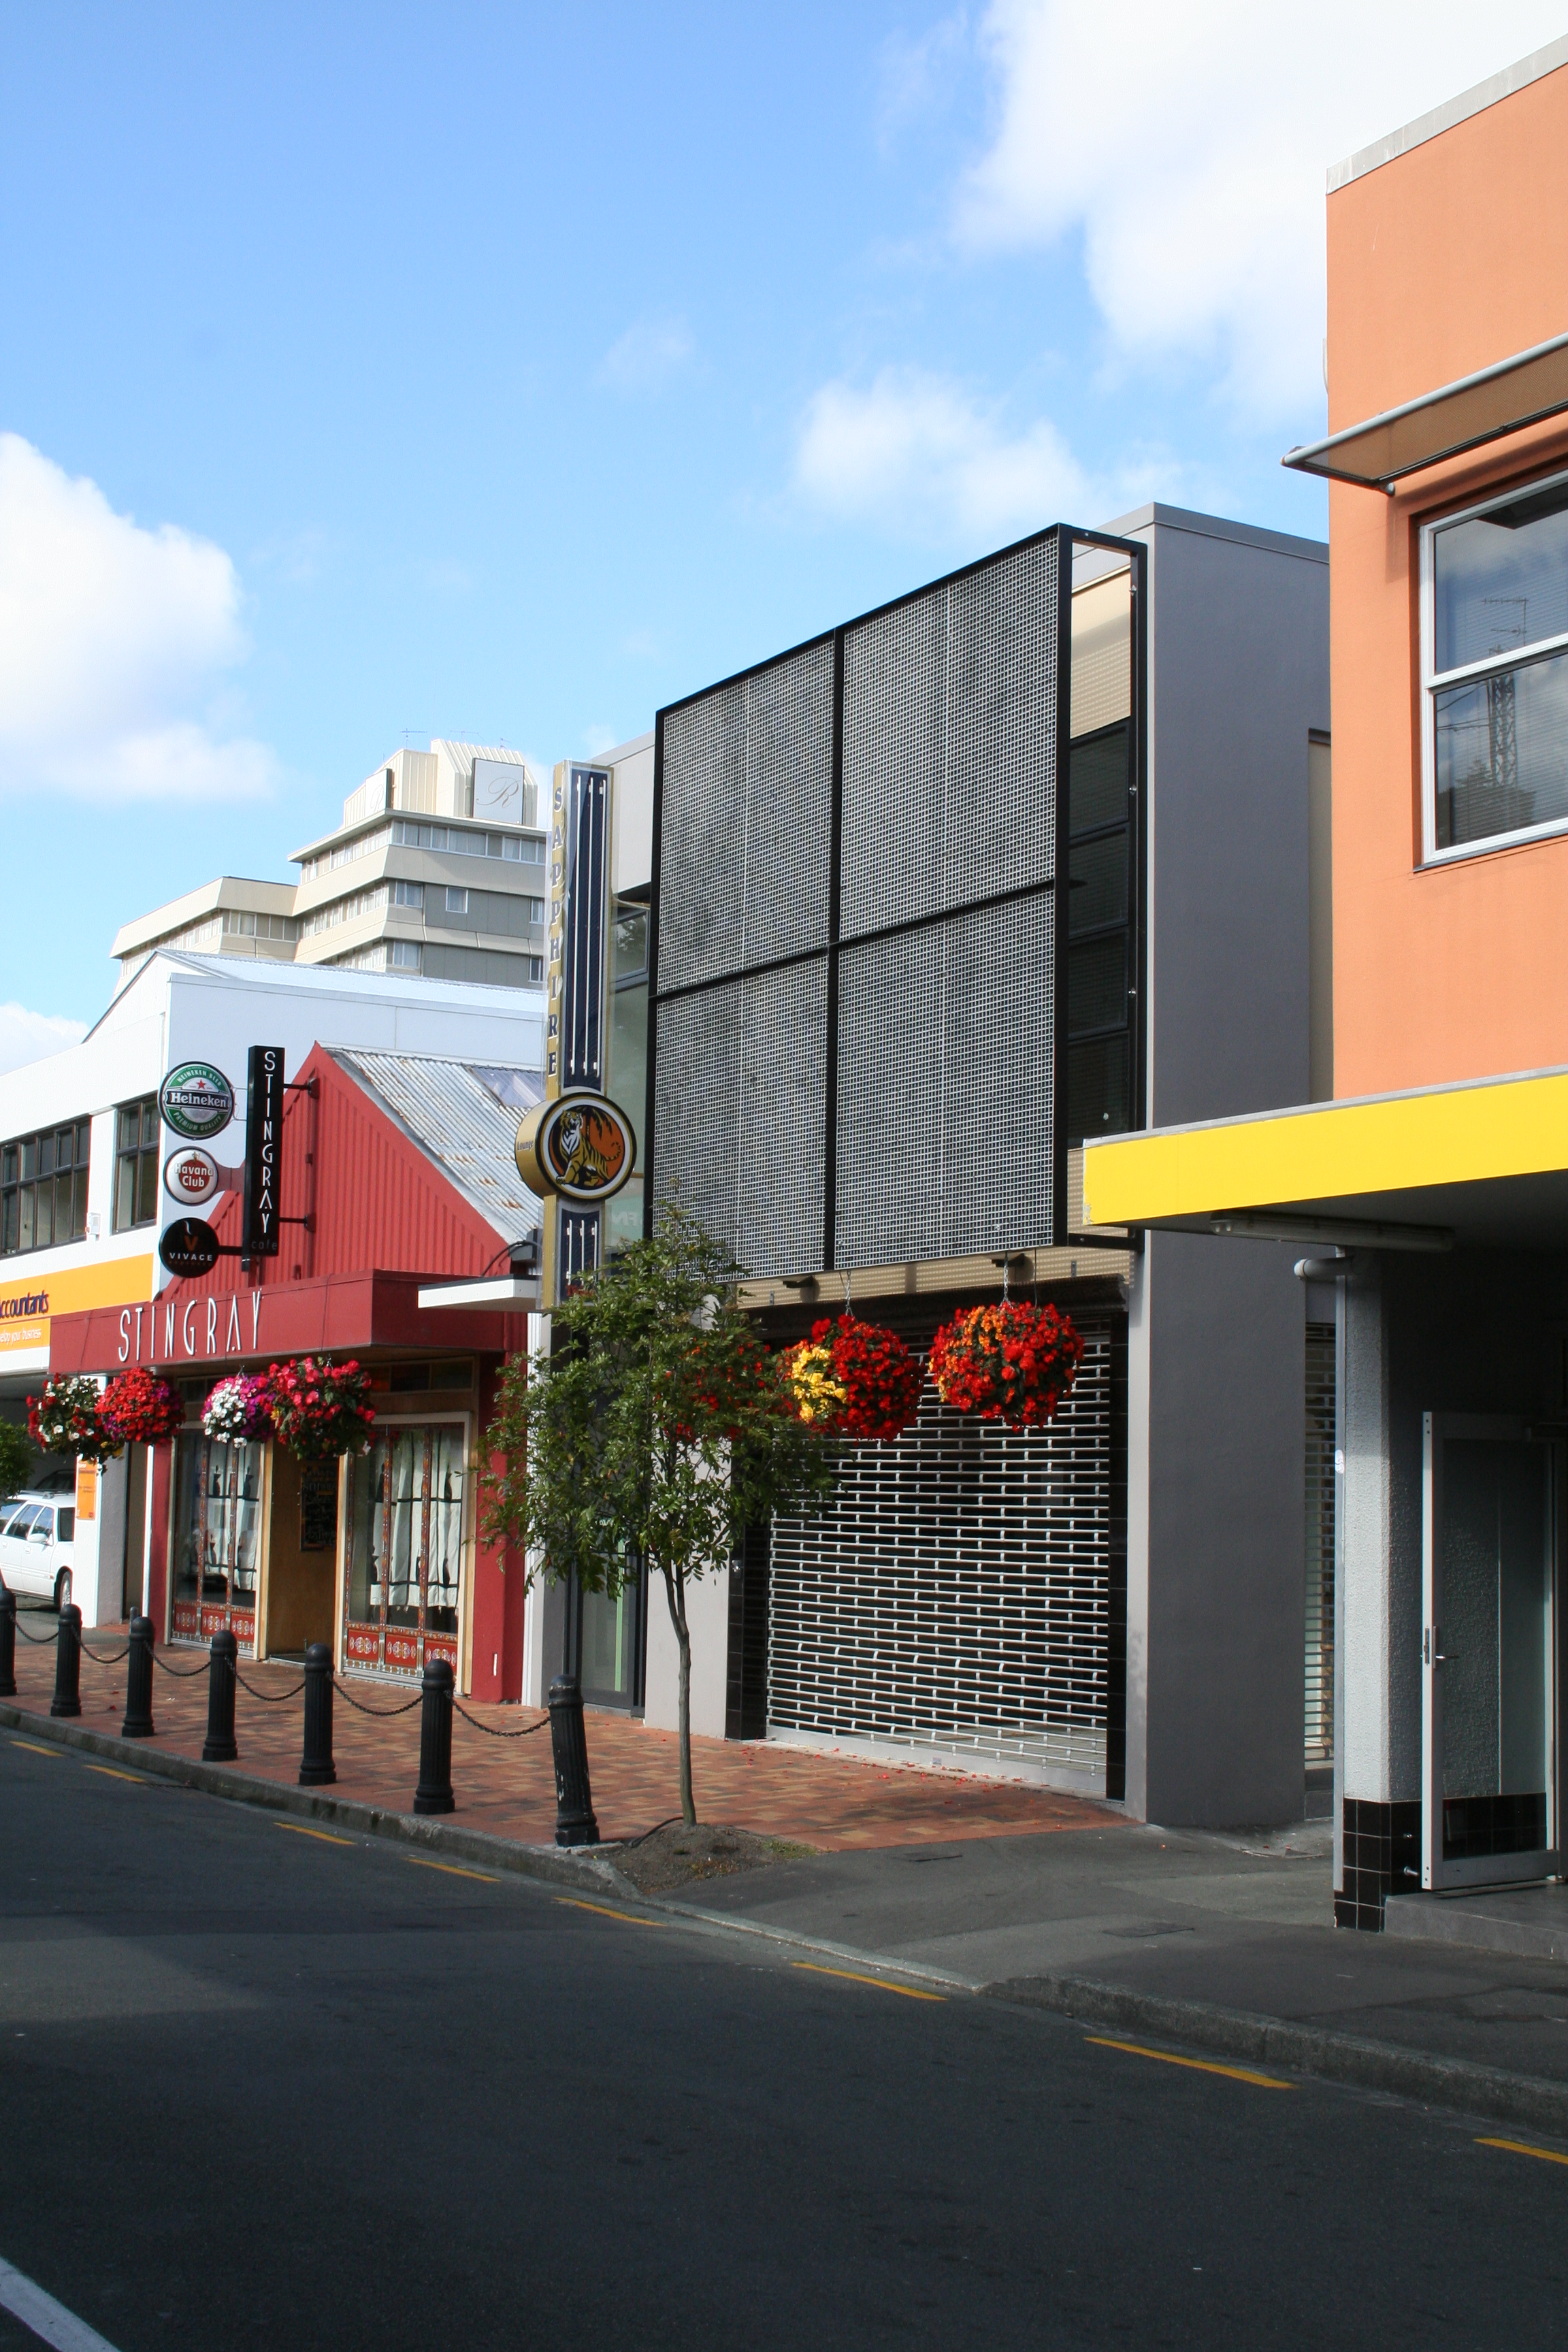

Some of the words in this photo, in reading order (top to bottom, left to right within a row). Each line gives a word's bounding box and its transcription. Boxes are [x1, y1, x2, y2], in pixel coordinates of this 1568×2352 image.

[476, 777, 521, 808] R
[547, 786, 564, 1077] SAPPHIRE
[177, 1069, 208, 1083] HEINEKEN
[170, 1092, 227, 1108] Heineken
[173, 1111, 199, 1130] PREMIUM
[199, 1115, 223, 1131] QUALITY
[259, 1050, 276, 1235] STINGRAY
[517, 1140, 534, 1152] Lounge
[174, 1163, 214, 1177] Havana
[182, 1175, 205, 1188] Club
[251, 1239, 278, 1250] cafe
[169, 1253, 213, 1261] VIVACE
[0, 1289, 50, 1318] ccountants
[118, 1290, 262, 1362] STINGRAY
[0, 1328, 11, 1345] elop
[11, 1331, 22, 1346] your
[22, 1326, 42, 1341] business
